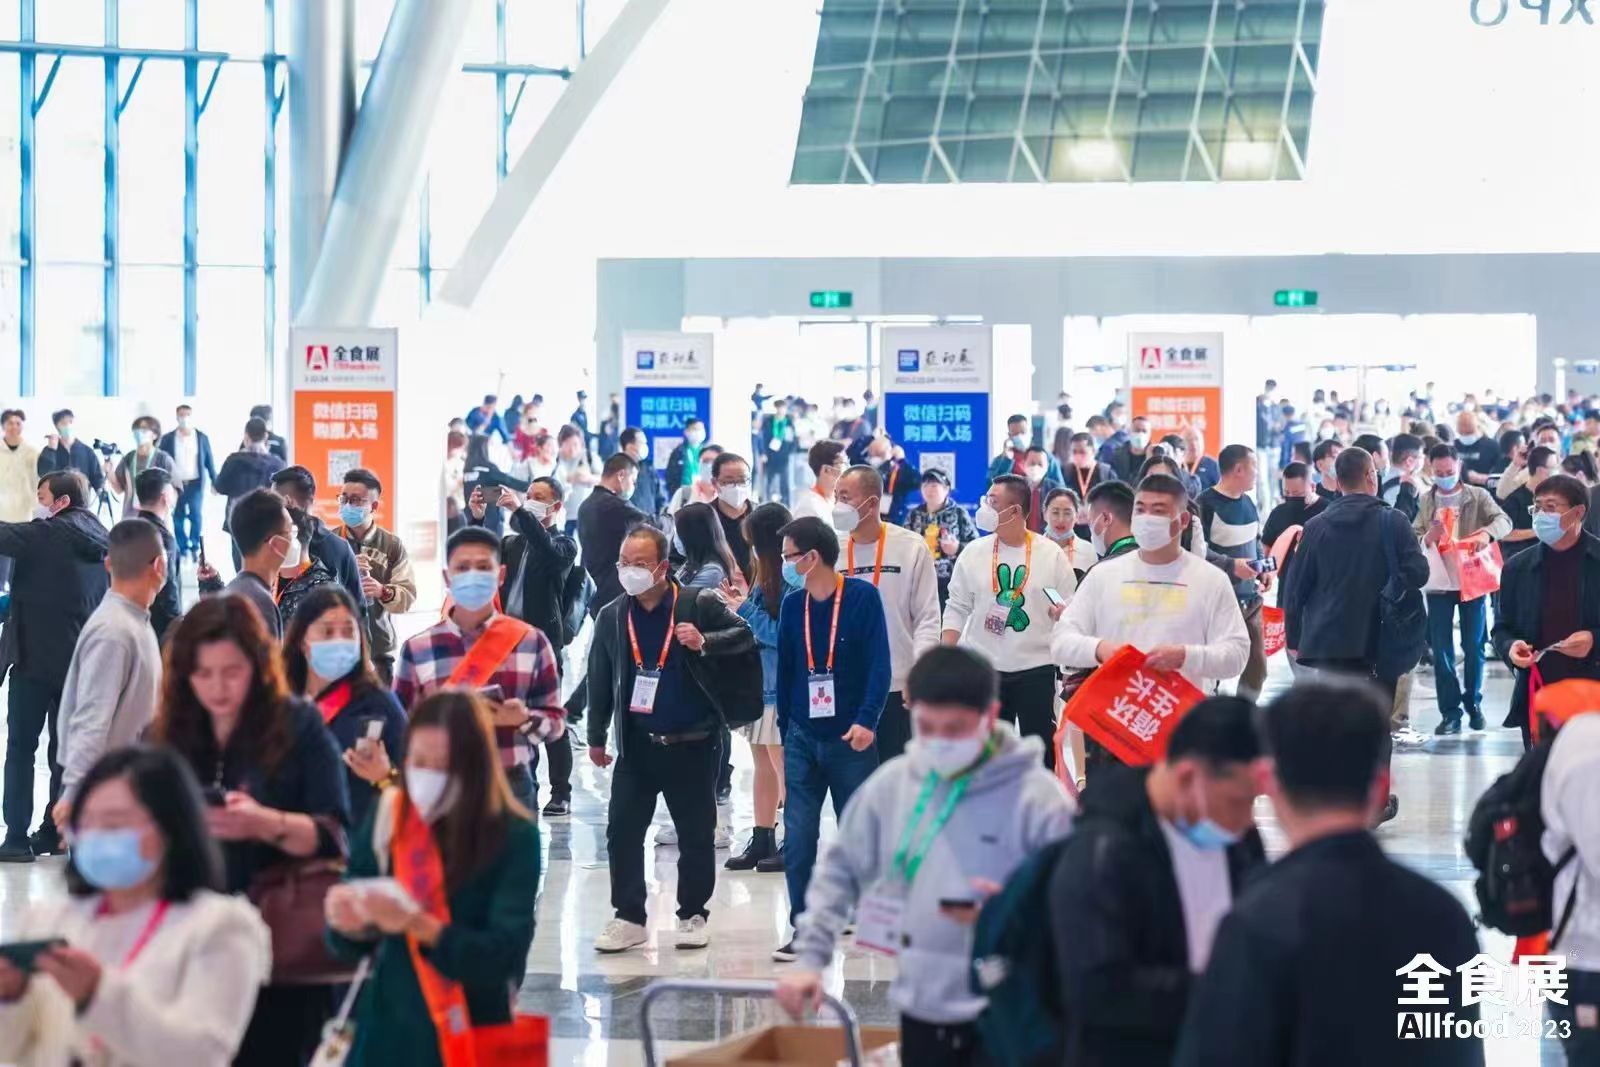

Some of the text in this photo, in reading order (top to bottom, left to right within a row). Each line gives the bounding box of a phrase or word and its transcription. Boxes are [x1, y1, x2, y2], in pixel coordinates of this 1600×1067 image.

[334, 345, 380, 361] 全食展
[1166, 346, 1208, 361] 全食展
[313, 402, 378, 420] 微信扫码
[904, 404, 971, 422] 微信扫码
[313, 421, 379, 440] 购票入场
[904, 424, 972, 442] 购票入场
[1125, 670, 1180, 718] 生长
[1106, 696, 1161, 742] 循环
